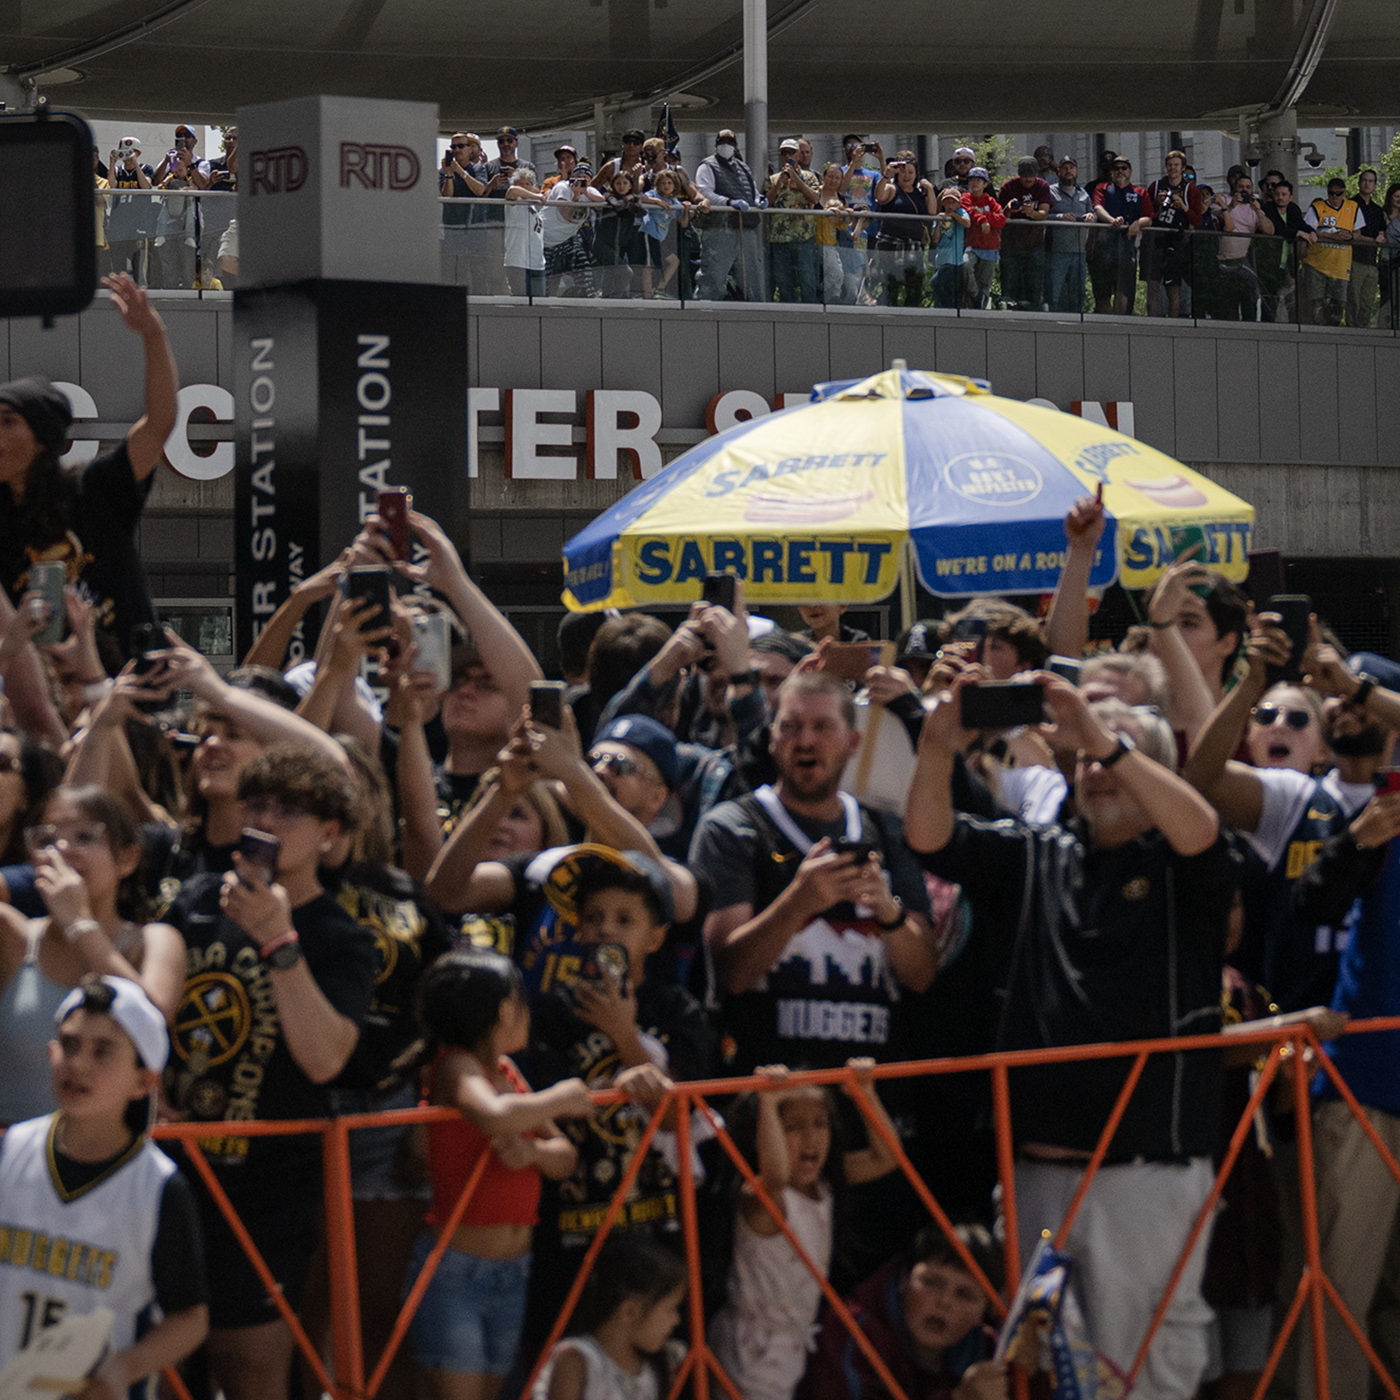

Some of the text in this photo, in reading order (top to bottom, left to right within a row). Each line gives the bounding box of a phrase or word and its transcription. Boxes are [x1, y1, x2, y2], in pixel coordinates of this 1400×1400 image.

[249, 145, 309, 197] RTD
[339, 141, 421, 191] RTD
[1322, 216, 1336, 227] 35
[162, 384, 663, 481] CER
[251, 337, 278, 563] STATION
[356, 333, 392, 526] TATION
[705, 452, 888, 498] SABRETT
[638, 540, 892, 585] SABRETT
[936, 555, 987, 577] WE'RE
[993, 553, 1016, 573] ON
[1019, 553, 1032, 571] A
[776, 999, 891, 1044] NUGGETS
